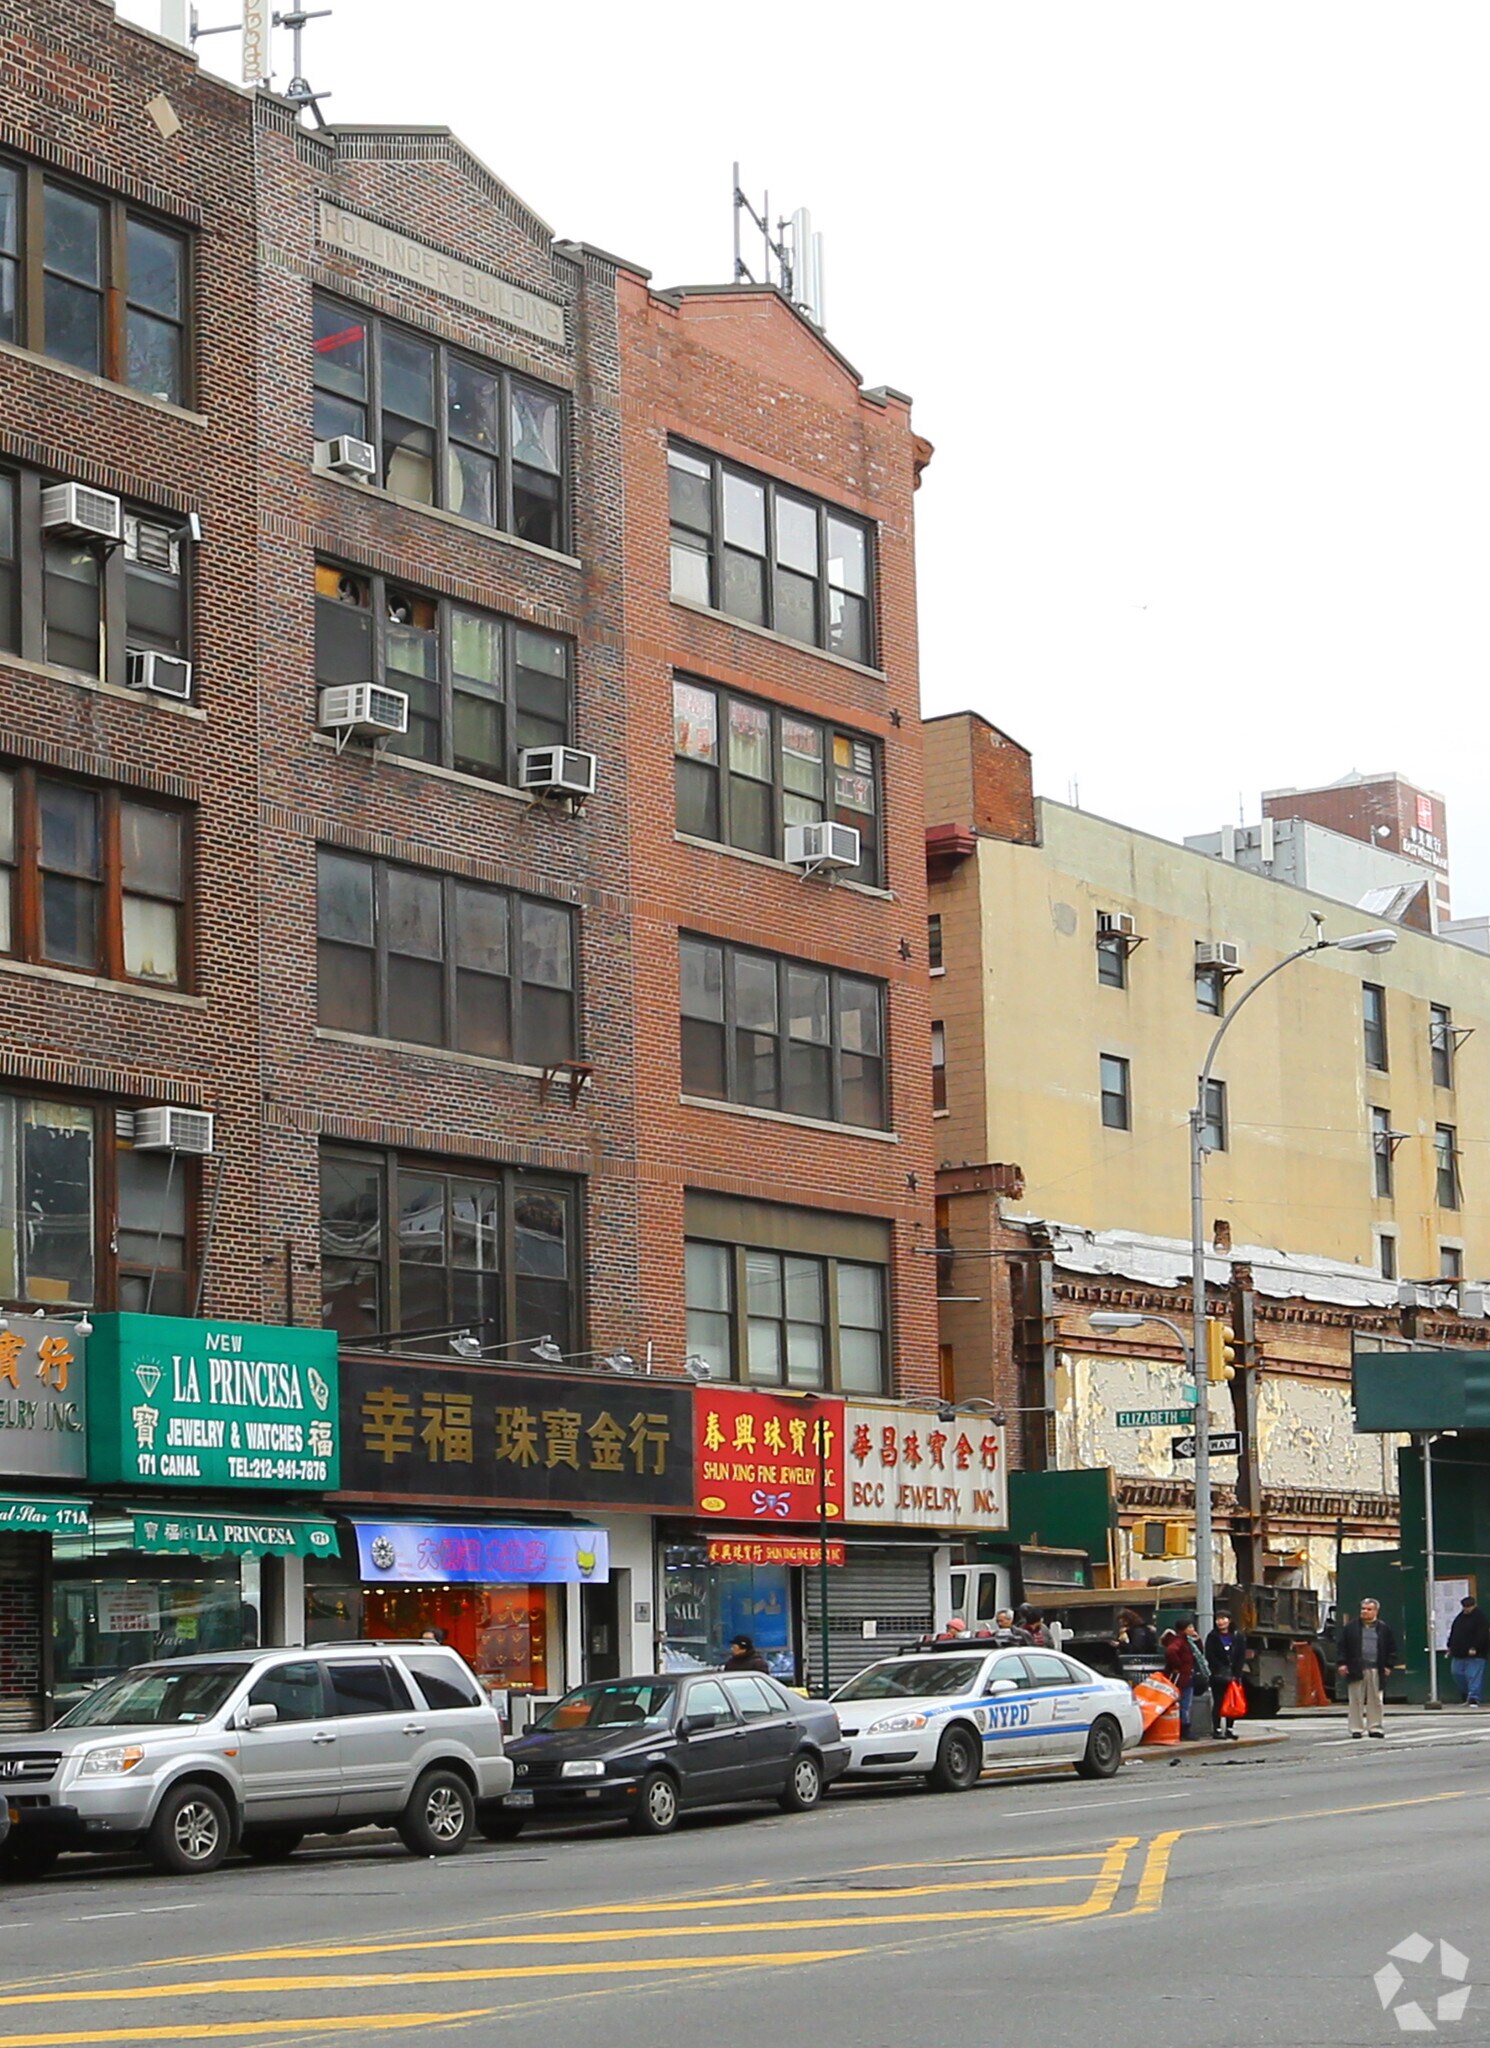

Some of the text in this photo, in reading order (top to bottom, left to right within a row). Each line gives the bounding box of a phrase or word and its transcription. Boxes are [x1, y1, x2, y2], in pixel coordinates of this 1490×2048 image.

[205, 1332, 243, 1353] NEW
[171, 1355, 304, 1410] LA PRINCESA
[44, 1402, 84, 1432] INC.
[131, 1402, 160, 1450] 寶
[1119, 1411, 1178, 1426] ELIZABETH
[166, 1417, 304, 1452] JEWELRY & WATCHES
[307, 1419, 334, 1457] 福
[361, 1386, 671, 1476] 幸福 珠寶金行
[702, 1411, 835, 1460] 春興珠寶行
[850, 1423, 999, 1472] 華昌珠寶金行
[1182, 1440, 1232, 1453] ON WAY
[137, 1454, 201, 1476] 171 CANAL
[227, 1456, 327, 1481] TEL:212-941-7876
[703, 1461, 730, 1481] SHUN
[732, 1463, 756, 1483] XING
[757, 1465, 777, 1484] FINE
[779, 1466, 816, 1486] JEWELRY
[851, 1482, 1000, 1515] BCC JEWELRY, INC.
[56, 1510, 88, 1525] 171A
[196, 1524, 219, 1542] LA
[223, 1525, 296, 1545] PRINCESA
[674, 1602, 701, 1620] SALE
[988, 1703, 1031, 1729] NYPD
